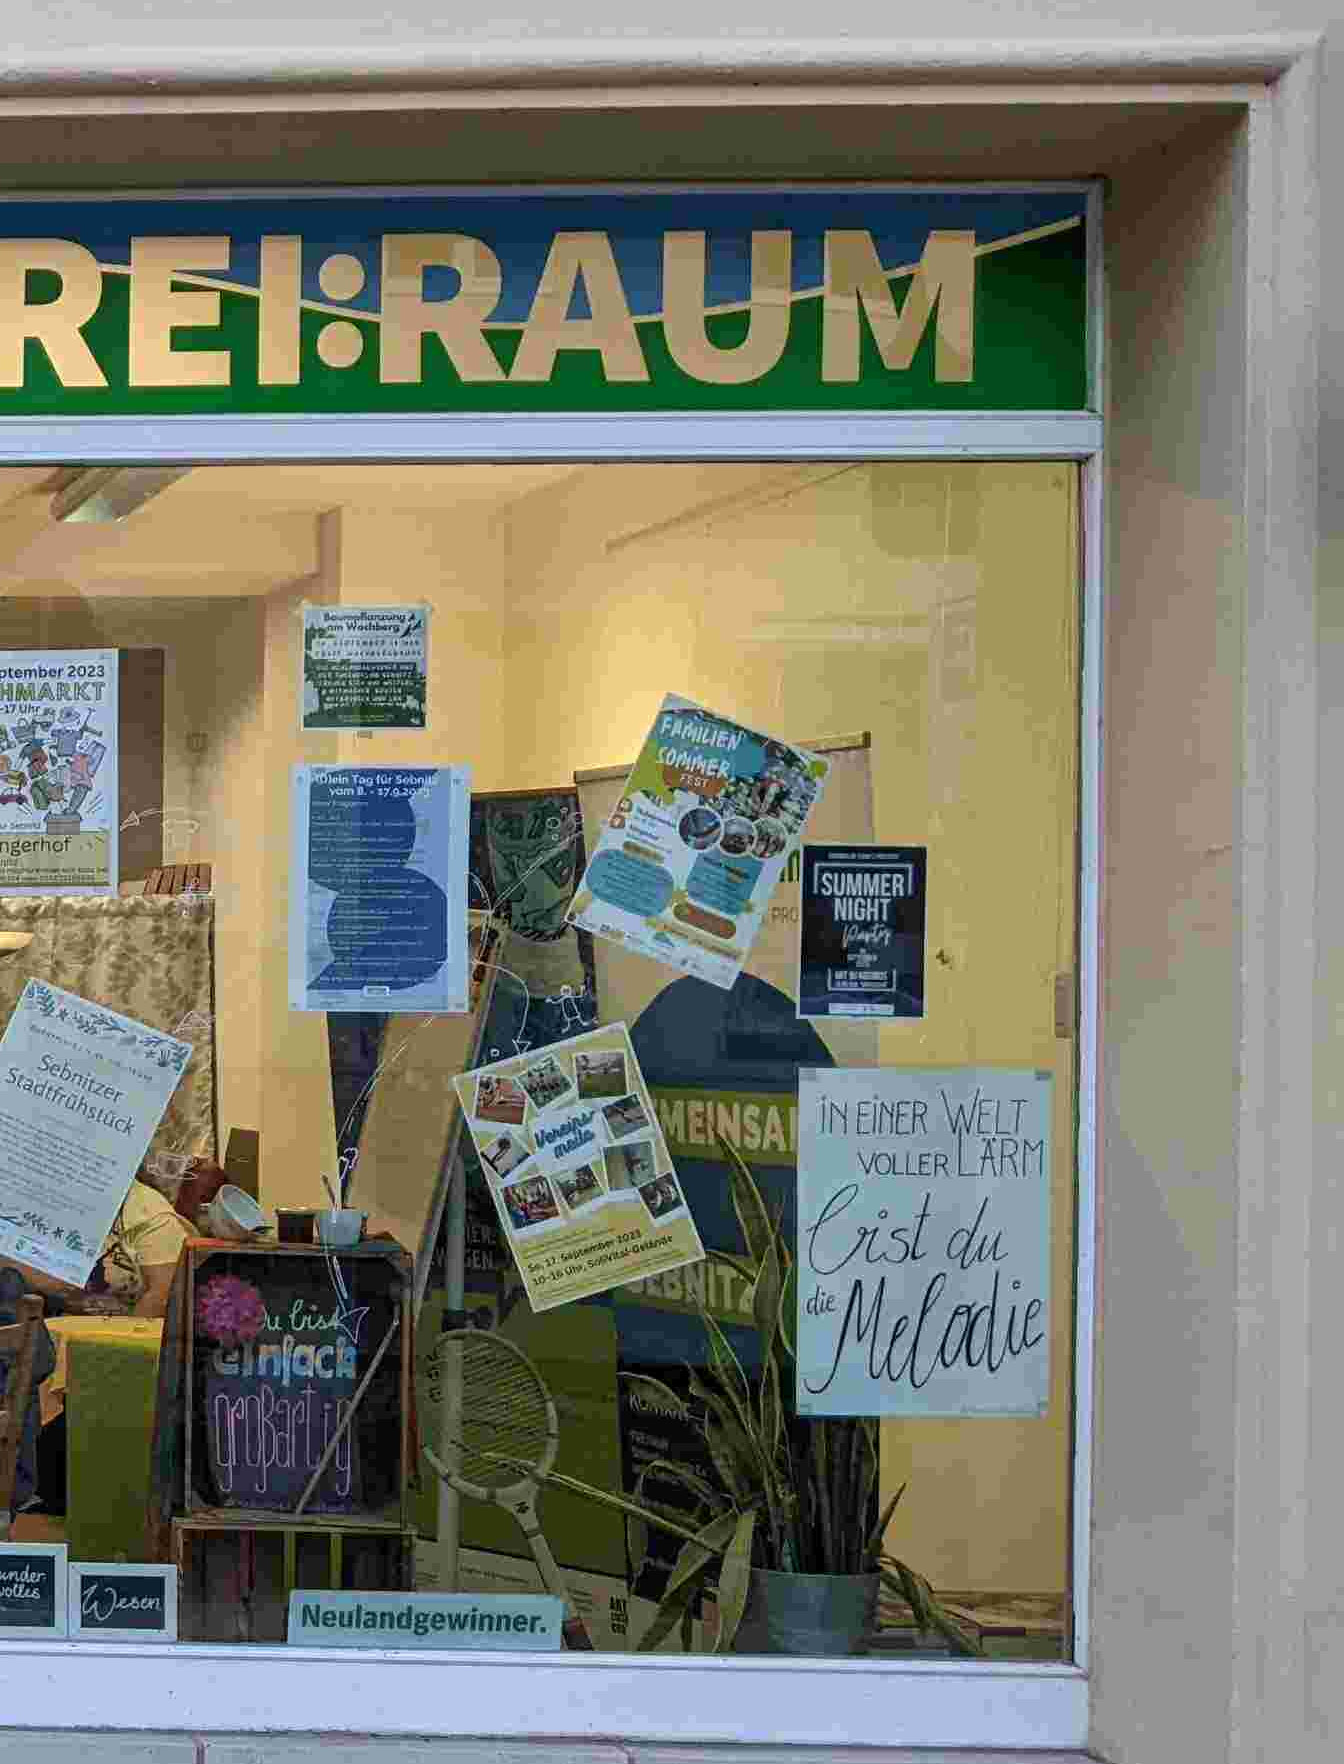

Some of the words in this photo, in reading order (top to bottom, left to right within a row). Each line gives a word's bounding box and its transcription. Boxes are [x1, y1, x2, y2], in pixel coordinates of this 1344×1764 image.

[67, 665, 105, 679] 2023
[19, 703, 40, 715] Uhr
[660, 715, 743, 751] FAMILIEN
[376, 773, 393, 786] für
[656, 746, 729, 780] SOMMER
[329, 787, 355, 797] vom
[821, 872, 905, 897] SUMMER
[833, 898, 891, 922] NIGHT
[38, 1053, 125, 1105] Sebnitzer
[4, 1066, 136, 1137] Stadtfrühstück
[820, 1095, 848, 1135] IN
[855, 1095, 929, 1135] EINER
[940, 1087, 1029, 1136] WELT
[657, 1098, 798, 1153] MEINSA
[857, 1151, 950, 1177] VOLLER
[957, 1128, 1045, 1179] LÄRM
[806, 1183, 931, 1275] bist
[946, 1195, 1009, 1270] du
[805, 1286, 837, 1316] die
[803, 1270, 1046, 1395] Melodie
[81, 1583, 162, 1622] Wesen
[301, 1603, 548, 1636] Neulandgewinner.
